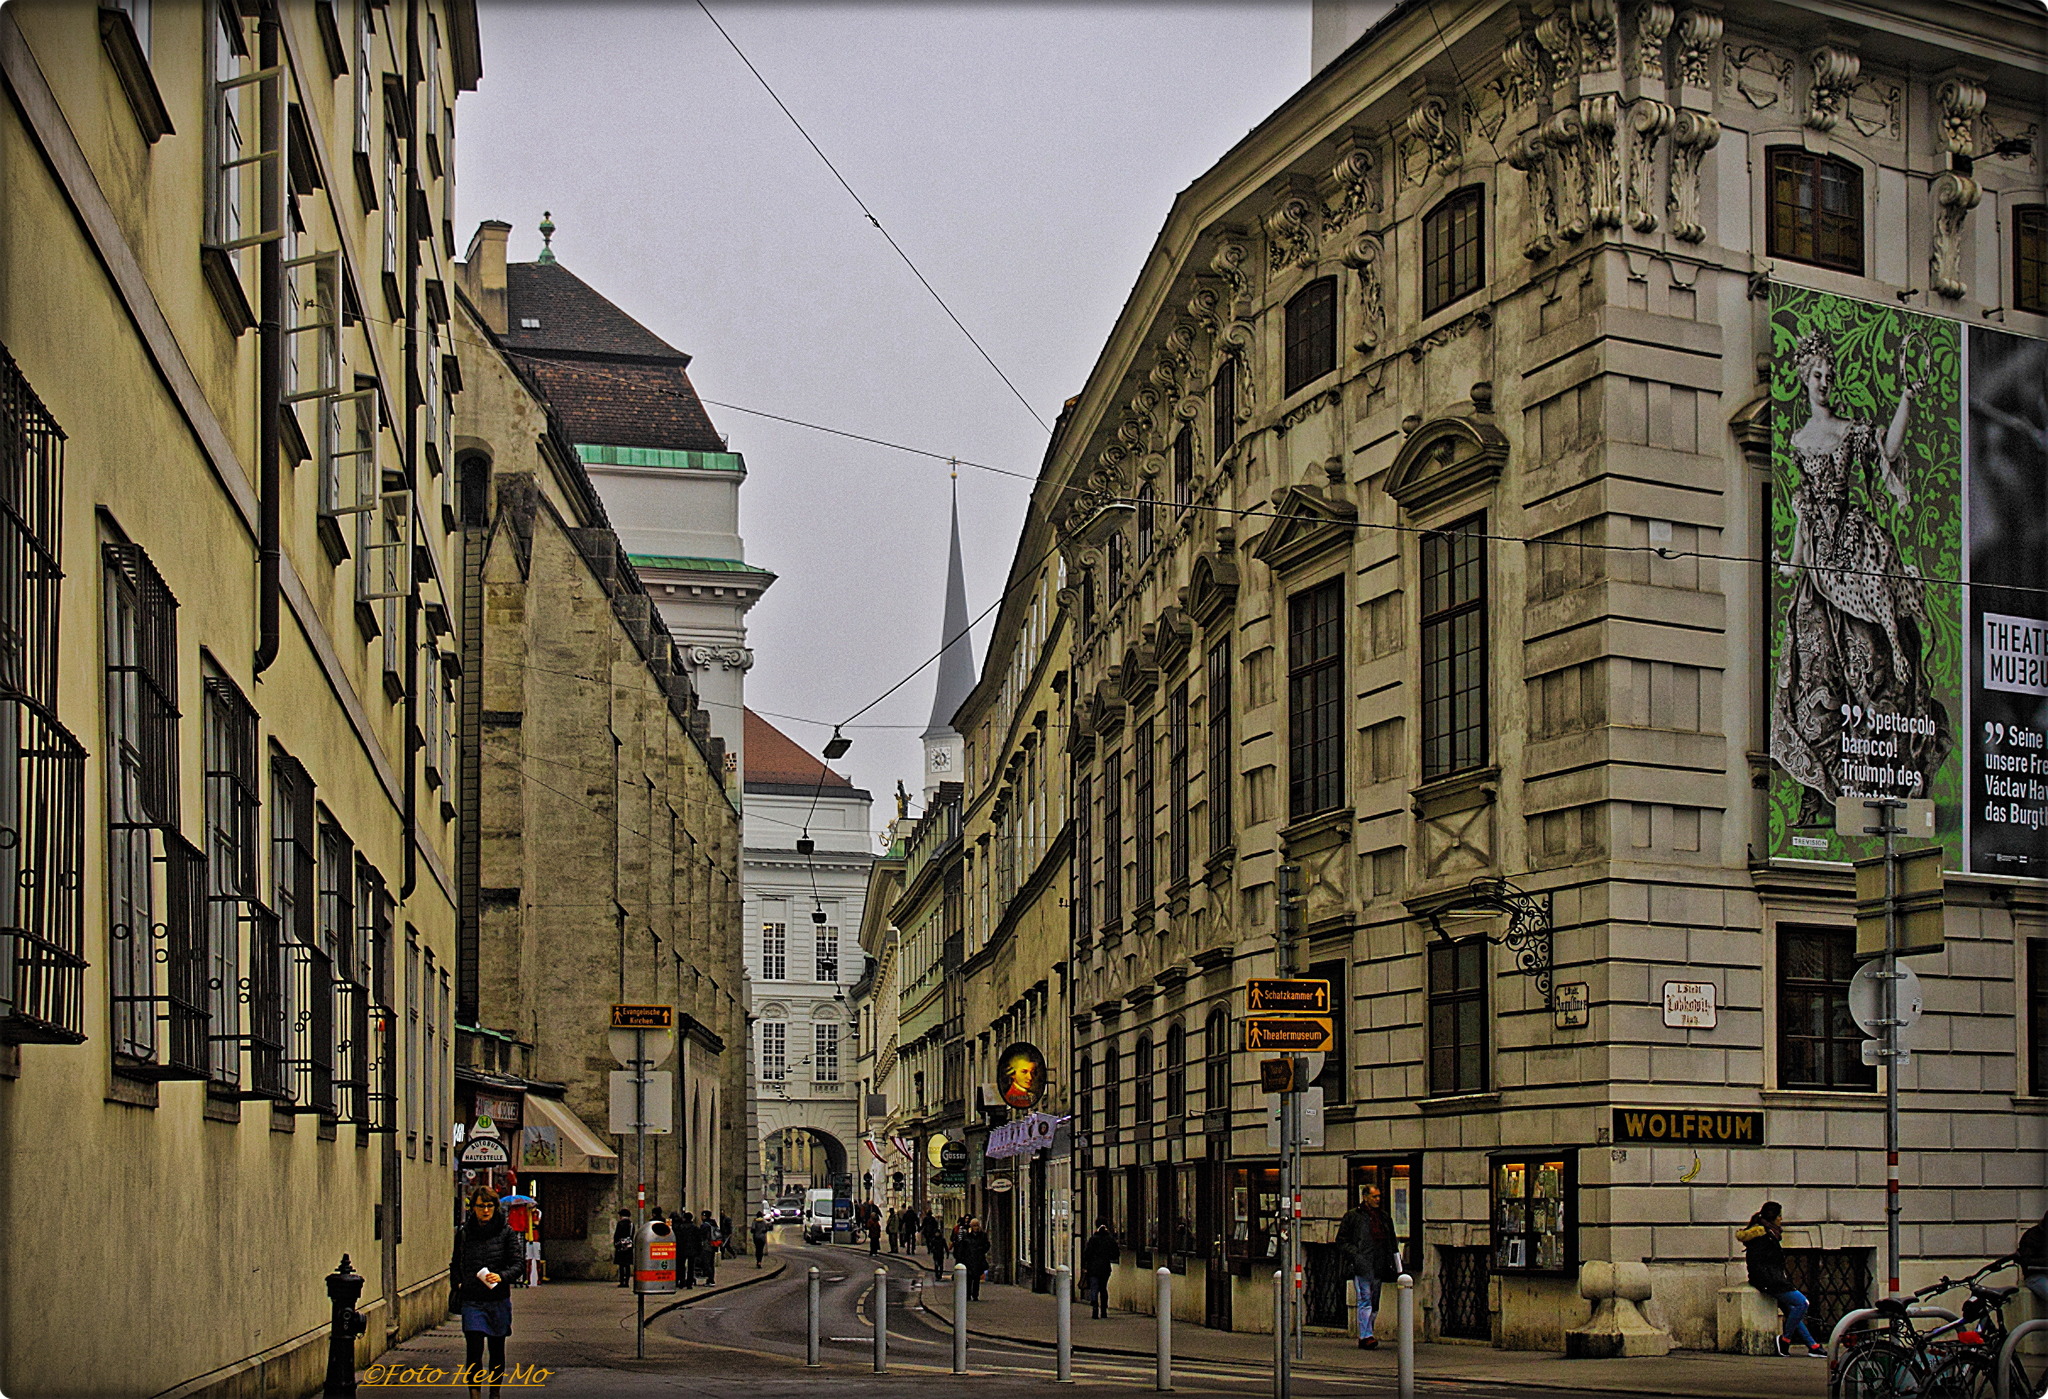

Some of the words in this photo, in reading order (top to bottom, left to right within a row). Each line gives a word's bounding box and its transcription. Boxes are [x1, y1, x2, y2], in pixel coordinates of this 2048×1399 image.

[1867, 708, 1936, 736] Spettacolo
[1841, 731, 1898, 758] barocco!
[2008, 725, 2043, 749] Seine
[1841, 758, 1895, 788] Triumph
[1897, 765, 1922, 786] des
[1985, 753, 2028, 773] unsere
[1985, 774, 2027, 798] Václav
[1985, 801, 2007, 822] das
[1264, 990, 1313, 1000] Schatzkammer
[1263, 1029, 1322, 1040] Theatermuseum
[1624, 1112, 1752, 1139] WOLFRUM
[471, 1140, 499, 1150] AUTOBUS
